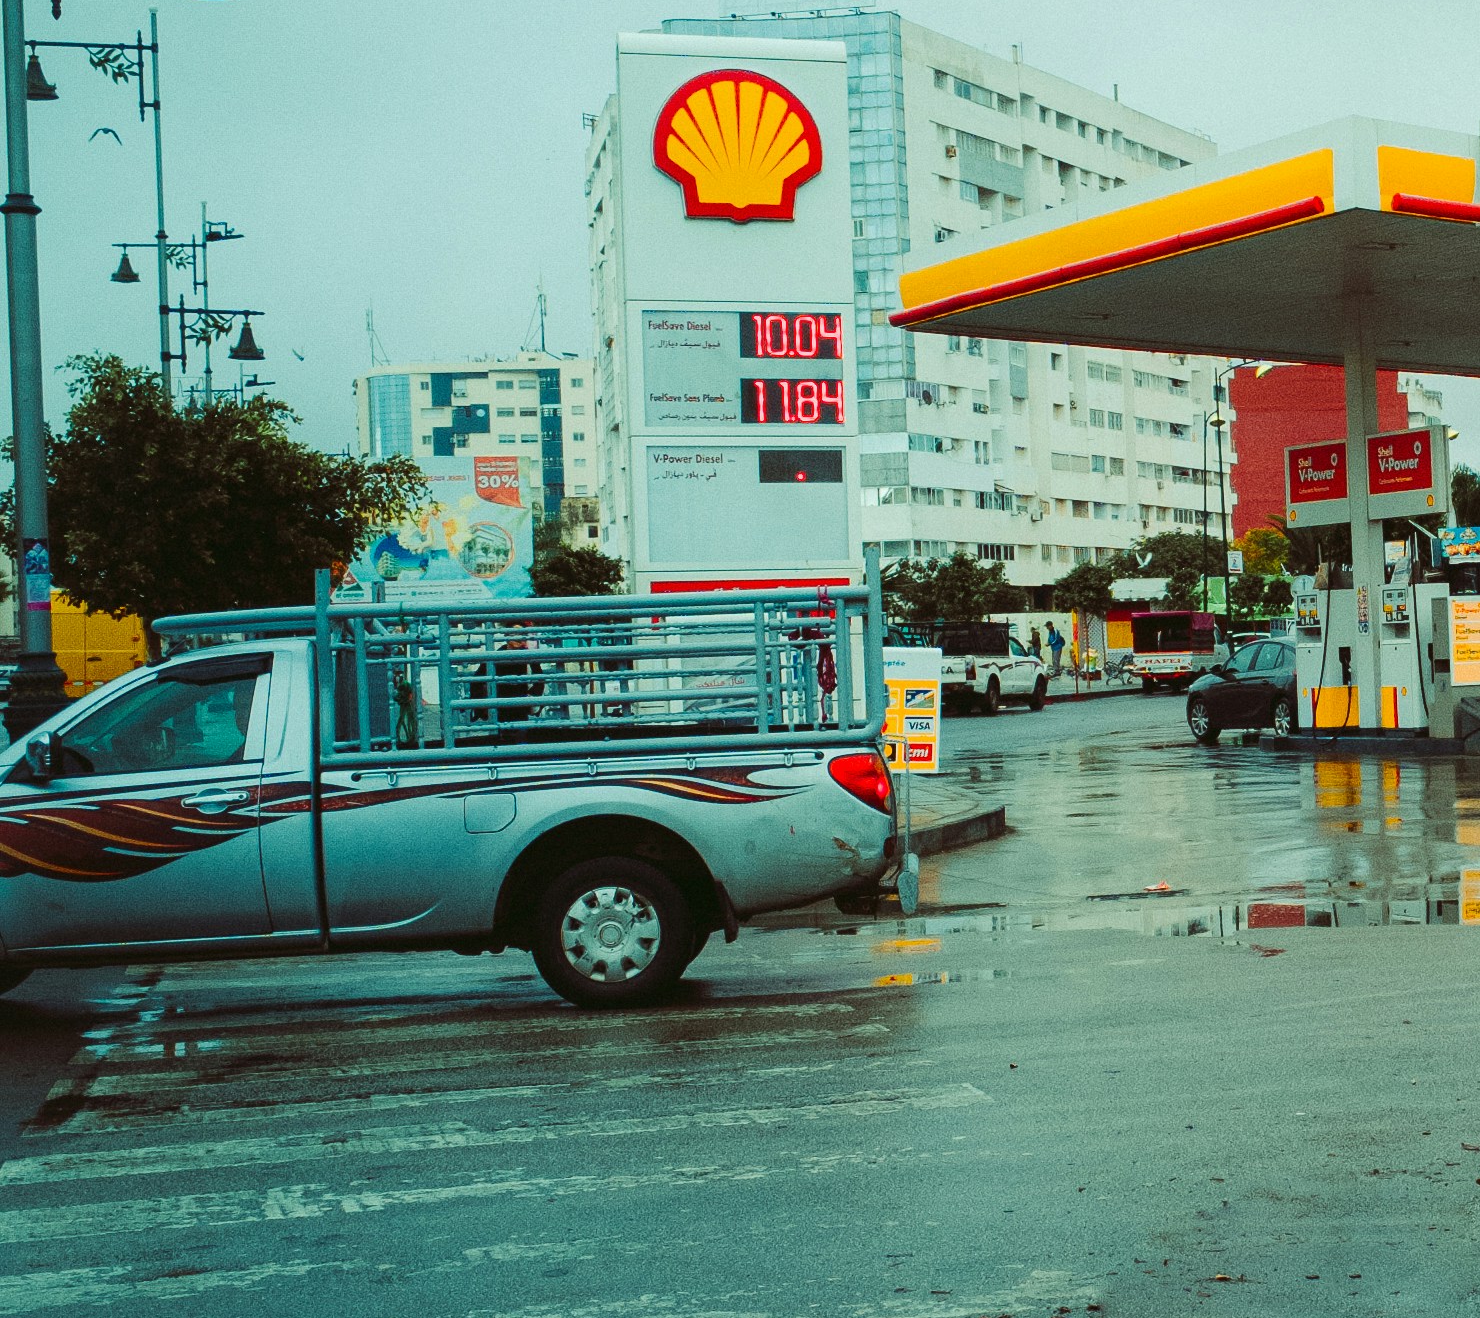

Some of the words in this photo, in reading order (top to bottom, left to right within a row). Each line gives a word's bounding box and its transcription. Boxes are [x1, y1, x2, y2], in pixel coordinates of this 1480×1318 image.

[648, 320, 684, 330] FuelSave
[687, 321, 711, 330] Diesel
[752, 314, 843, 359] 10.04
[650, 393, 681, 402] FuelSave
[754, 379, 845, 423] 11.84
[1378, 445, 1393, 457] Shell
[653, 454, 693, 463] V-Power
[696, 453, 723, 463] Diesel
[1298, 456, 1312, 468] Shell
[1379, 457, 1419, 472] V-Power
[478, 475, 519, 488] 30%
[1298, 469, 1335, 483] V-Power
[909, 721, 930, 730] VISA
